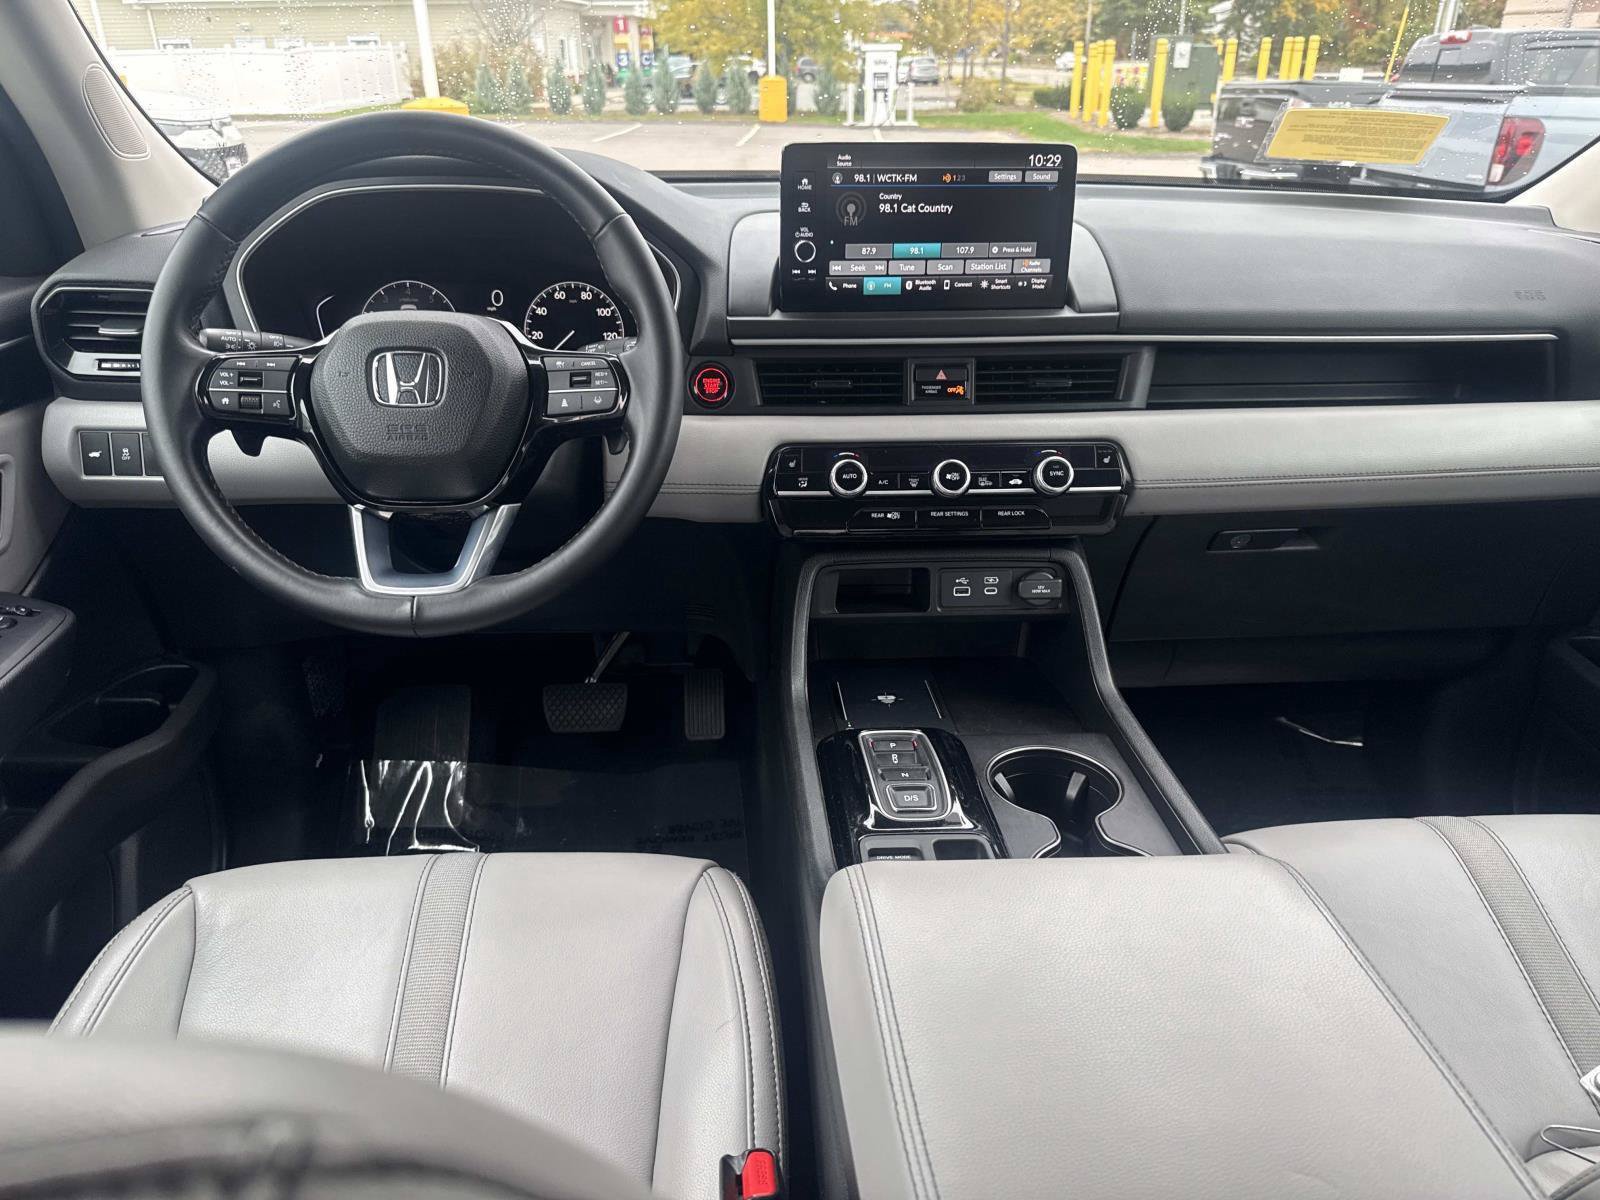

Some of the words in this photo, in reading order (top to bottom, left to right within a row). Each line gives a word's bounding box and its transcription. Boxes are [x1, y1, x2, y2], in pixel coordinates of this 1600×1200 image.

[1028, 154, 1062, 167] 10:29
[854, 174, 871, 183] 98.1
[877, 174, 918, 183] WCTK-FM
[994, 173, 1017, 182] Settings
[1032, 172, 1051, 181] Sound
[879, 192, 903, 201] Country
[879, 203, 898, 213] 98.1
[900, 203, 917, 213] Cat
[918, 203, 954, 215] Country
[844, 216, 858, 226] FM
[861, 247, 877, 255] 87.9
[909, 247, 924, 255] 98.1
[956, 246, 975, 254] 107.9
[850, 264, 866, 272] Seek
[899, 263, 915, 271] Tune
[937, 263, 954, 271] Scan
[970, 262, 993, 271] Station
[994, 262, 1007, 270] List
[491, 289, 504, 307] 0
[554, 291, 566, 300] 60
[580, 291, 593, 300] 80
[535, 307, 547, 316] 40
[596, 307, 611, 317] 100
[531, 331, 543, 340] 20
[602, 332, 617, 341] 120
